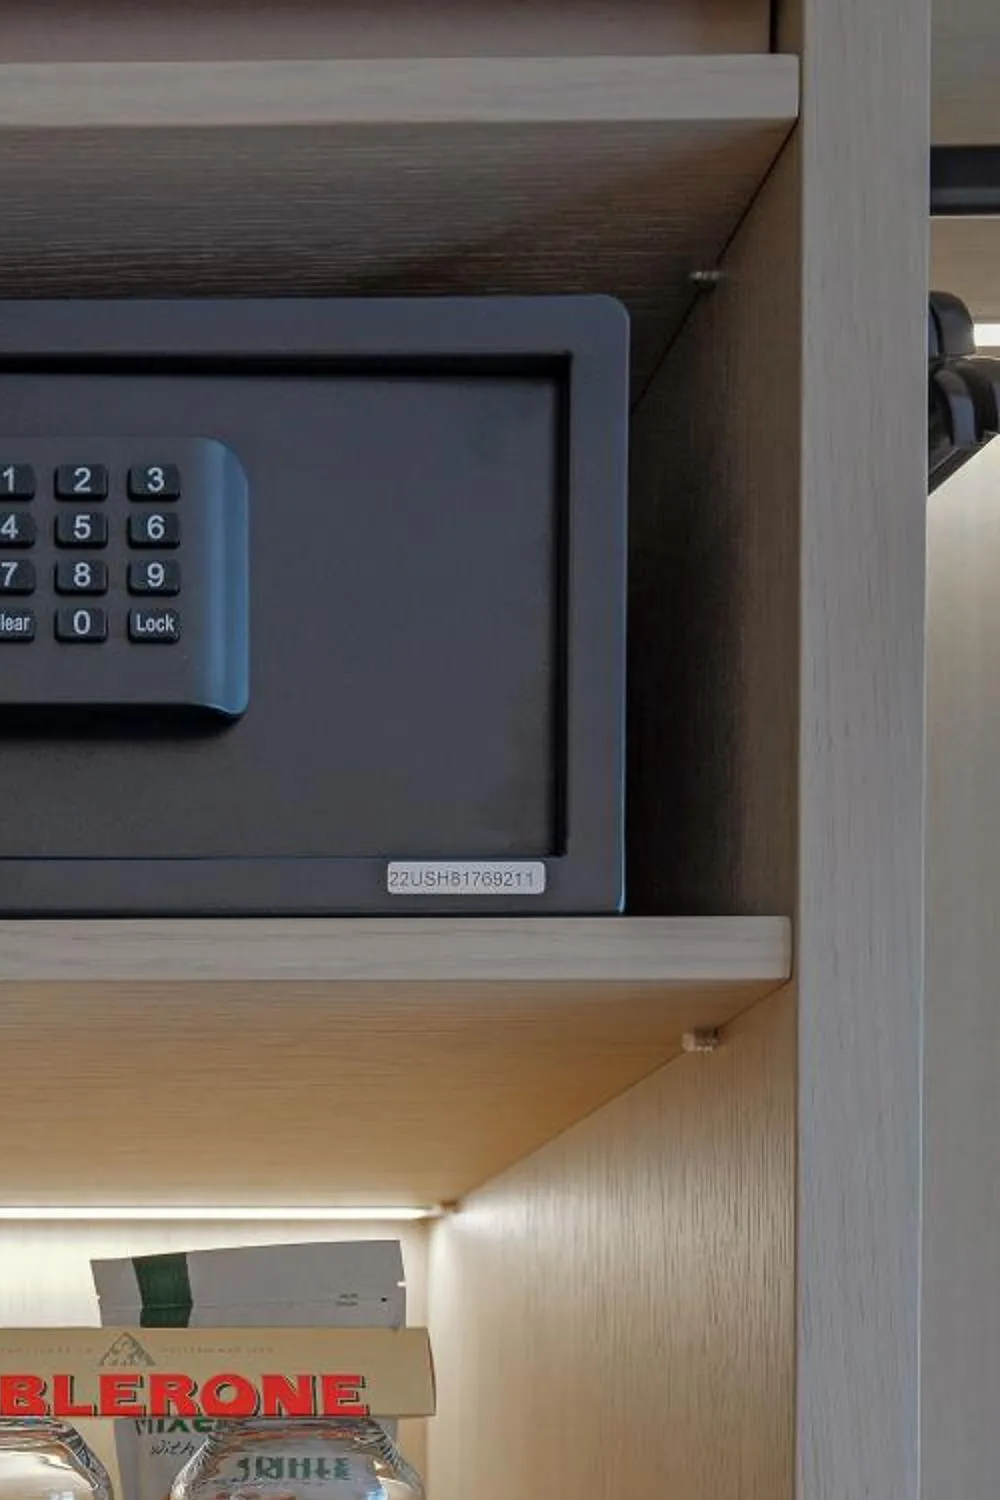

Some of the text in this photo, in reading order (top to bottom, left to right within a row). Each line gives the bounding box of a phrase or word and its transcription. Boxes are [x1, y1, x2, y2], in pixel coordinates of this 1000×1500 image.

[2, 468, 164, 491] 1 2 3
[0, 515, 164, 539] 4 5 6
[1, 563, 164, 587] 7 8 9
[74, 611, 91, 634] 0
[136, 613, 175, 633] Lock
